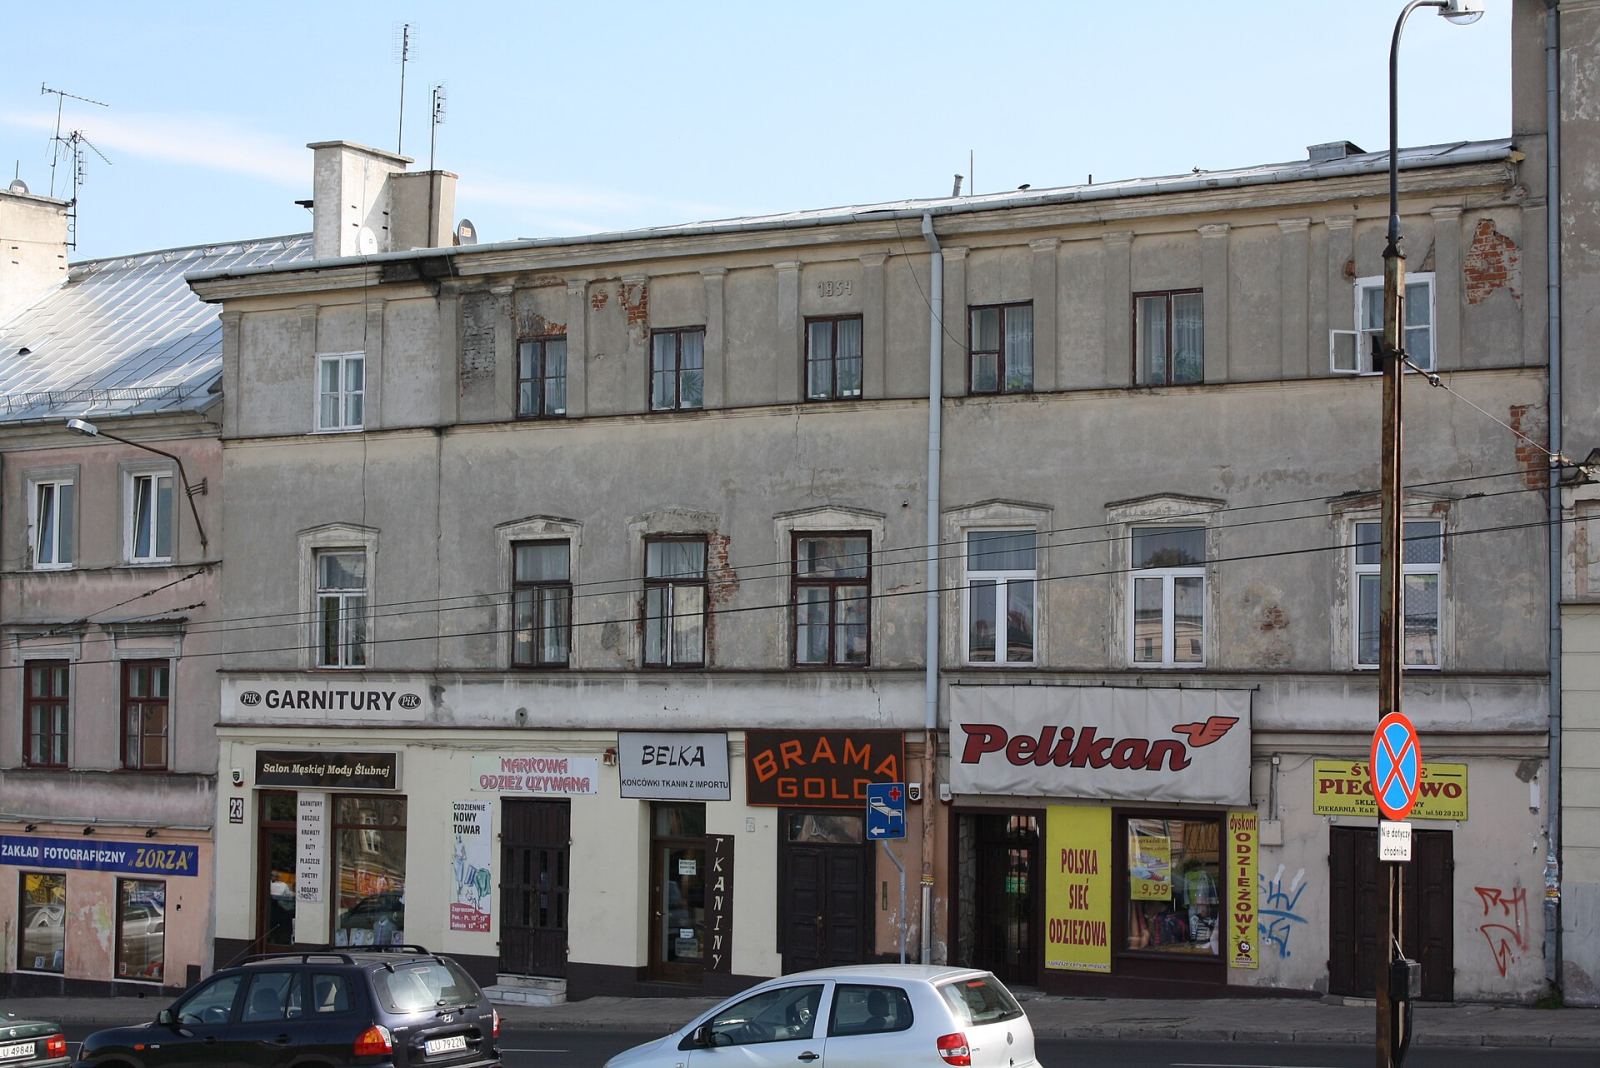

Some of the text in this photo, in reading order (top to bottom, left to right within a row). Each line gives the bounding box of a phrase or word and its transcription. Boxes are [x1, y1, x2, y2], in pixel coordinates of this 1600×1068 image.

[265, 689, 397, 711] GARNITURY
[641, 745, 706, 767] BELKA
[960, 723, 1192, 772] Pelikan
[501, 758, 568, 775] MARKOWA
[752, 736, 899, 783] BRAMA
[263, 762, 390, 778] Salon Męskiej Mody Ślubnej
[622, 778, 729, 789] KOŃCÓWKI TKANIN Z IMPORTU
[1319, 778, 1463, 799] PIECWO
[230, 799, 243, 818] 23
[453, 803, 486, 811] CODZIENNIE
[1318, 805, 1356, 813] PIEKARNIA
[453, 812, 477, 822] NOWY
[1230, 813, 1257, 834] dyskont
[453, 824, 481, 835] TOWAR
[1, 844, 39, 858] ZAKŁAD
[44, 847, 126, 864] FOTOGRAFICZNY
[1061, 848, 1098, 875] POLSKA
[1069, 878, 1089, 911] SIEĆ
[429, 1040, 441, 1051] LU
